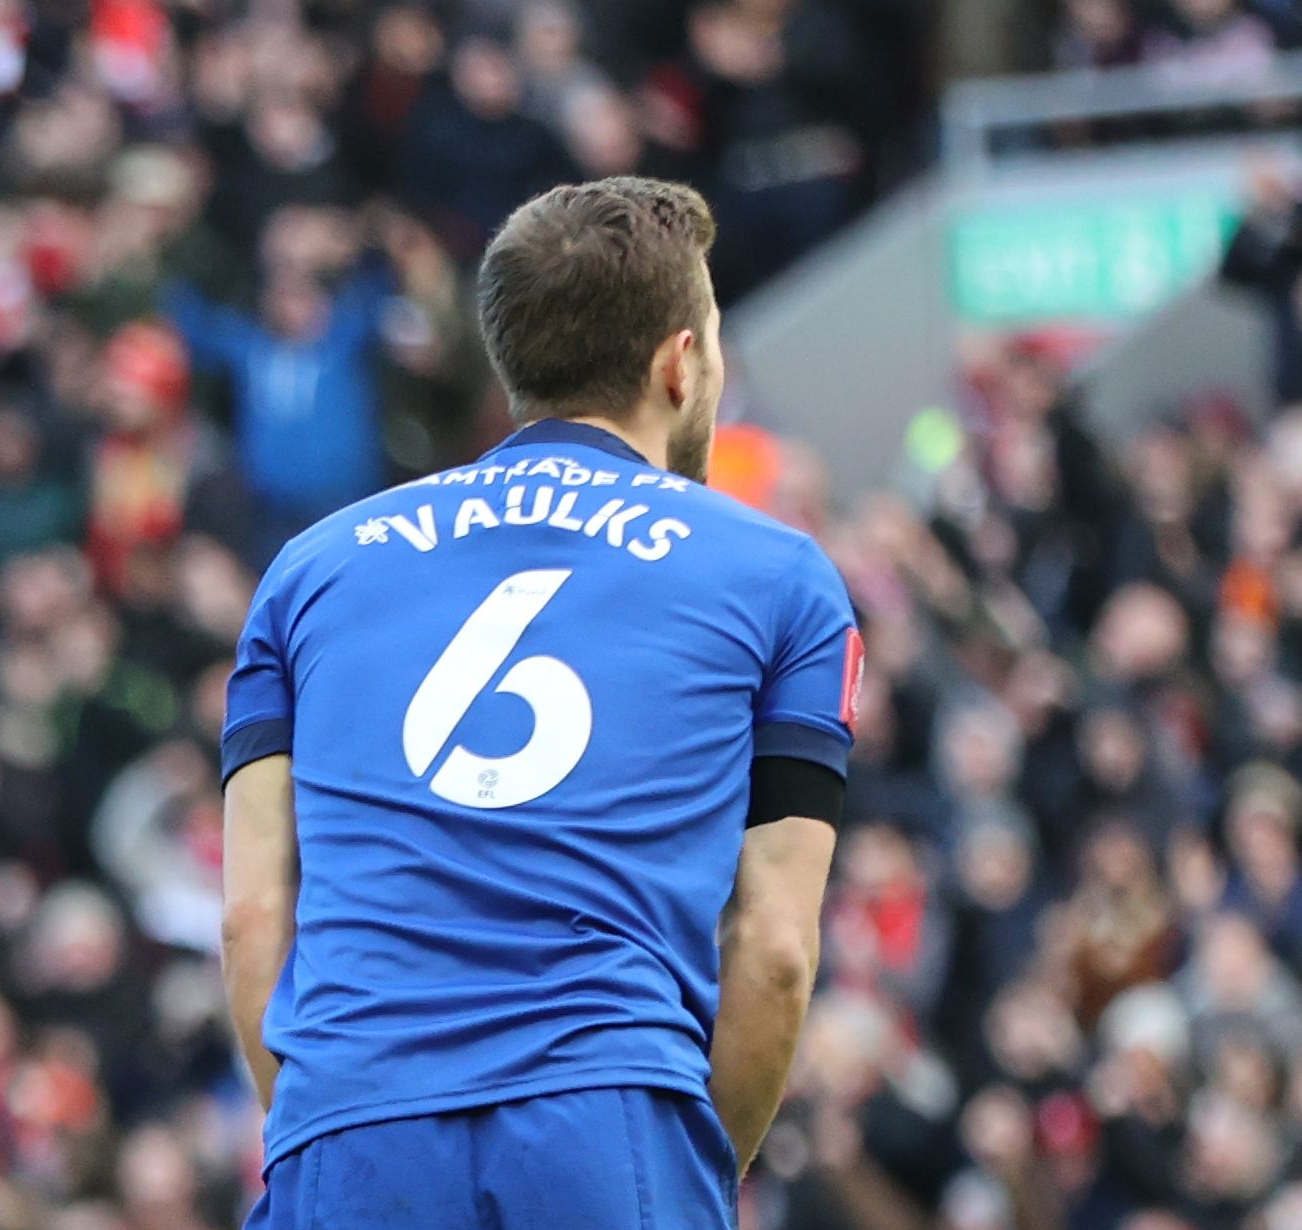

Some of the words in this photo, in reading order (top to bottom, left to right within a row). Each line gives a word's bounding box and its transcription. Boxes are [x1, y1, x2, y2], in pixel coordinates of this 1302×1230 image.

[631, 474, 691, 493] FX
[386, 485, 692, 561] VAULKS
[402, 568, 593, 809] 6
